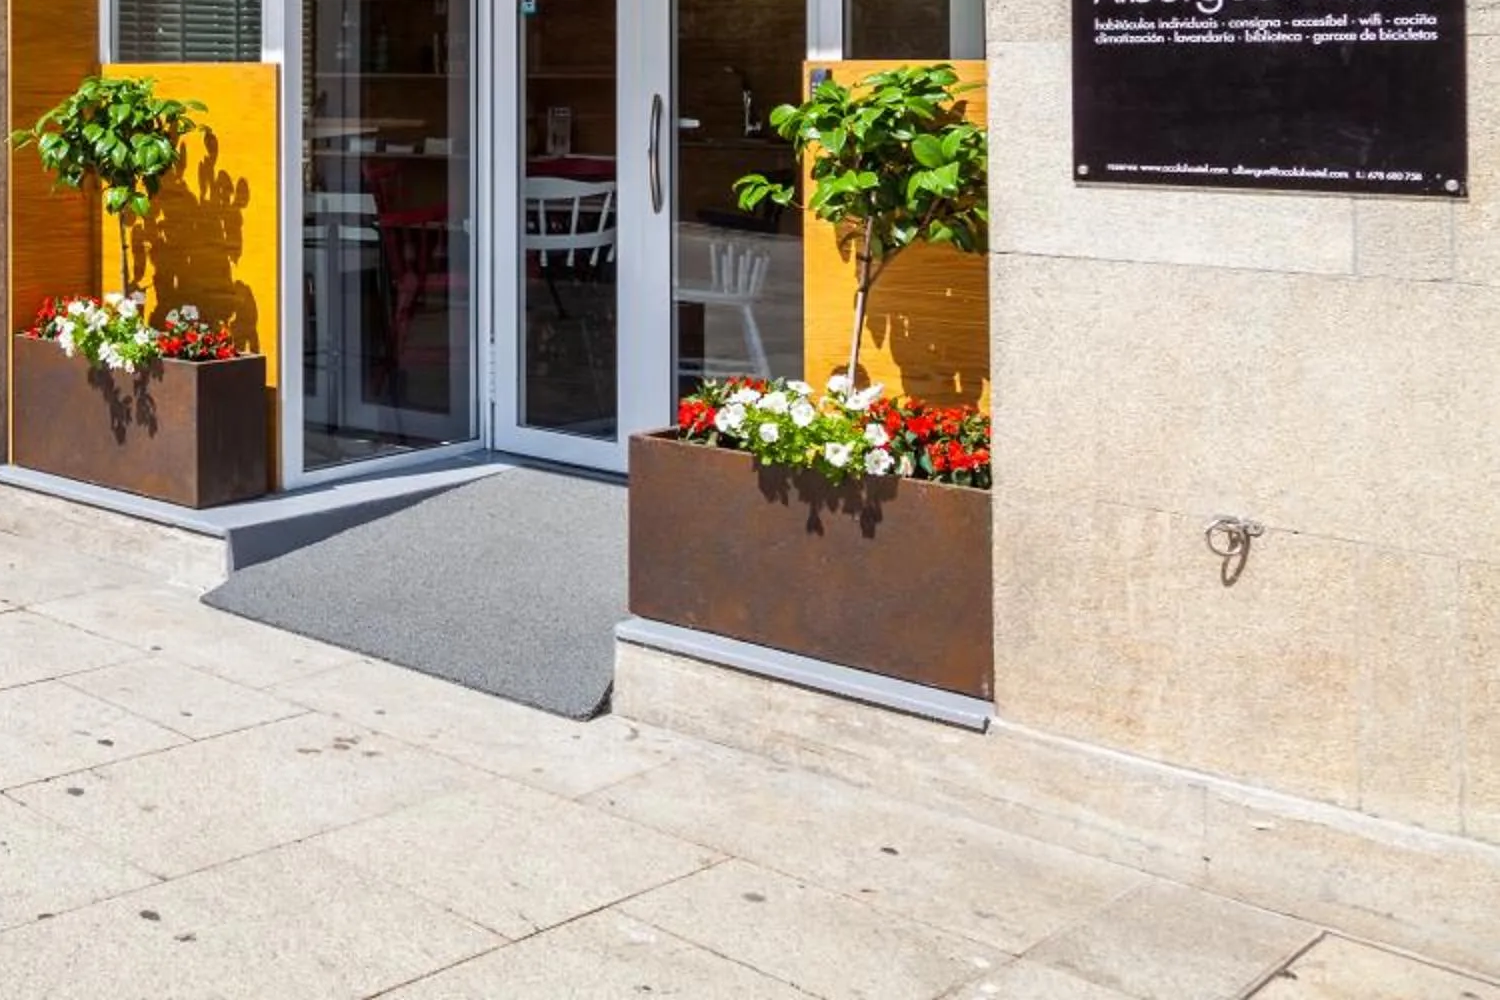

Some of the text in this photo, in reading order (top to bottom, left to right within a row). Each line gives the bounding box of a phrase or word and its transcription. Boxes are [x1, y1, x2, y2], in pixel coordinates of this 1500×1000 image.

[1157, 16, 1218, 29] individuais
[1228, 16, 1280, 30] consigna
[1358, 11, 1382, 26] wifi
[1393, 12, 1437, 25] cociña
[1245, 29, 1302, 43] biblioteca
[1359, 27, 1376, 41] de
[1379, 27, 1438, 41] bicicletas
